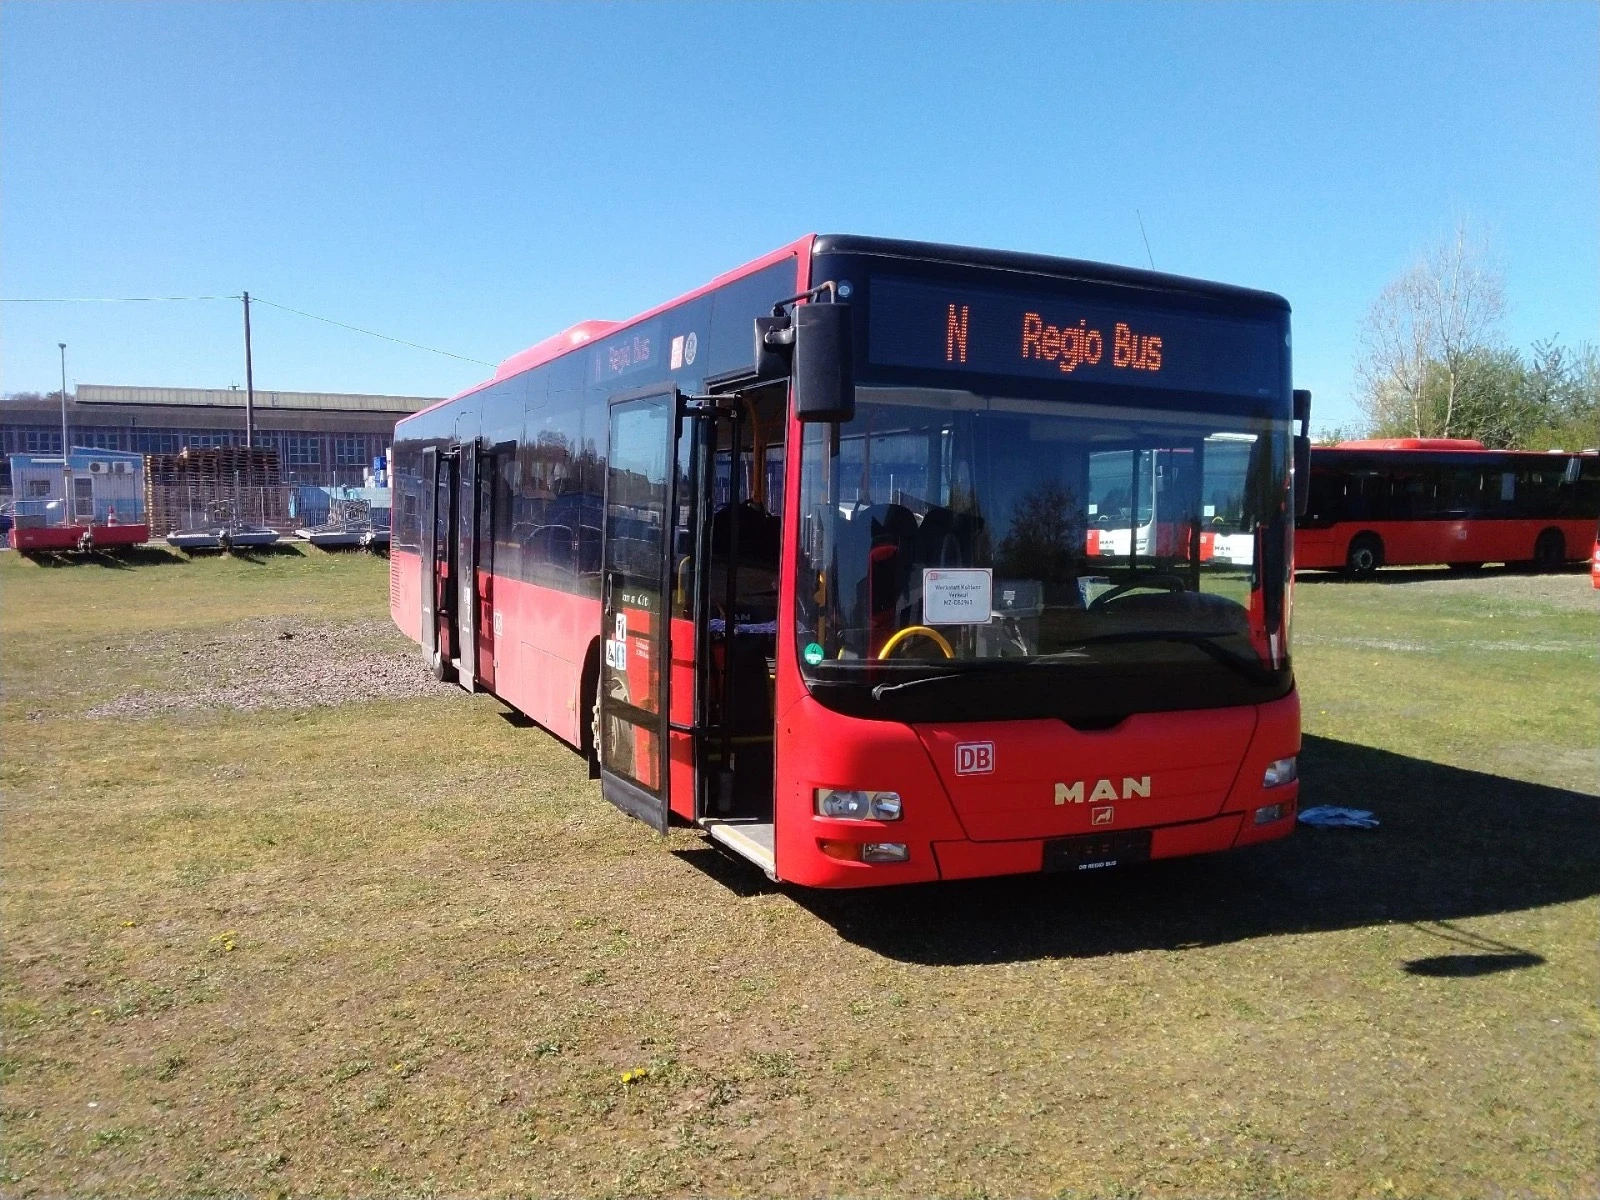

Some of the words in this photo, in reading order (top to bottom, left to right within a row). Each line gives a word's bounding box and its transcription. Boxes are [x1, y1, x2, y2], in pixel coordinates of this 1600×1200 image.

[946, 303, 969, 363] N
[1021, 312, 1102, 372] Regio
[1113, 322, 1162, 371] Bus
[811, 644, 817, 654] 4
[958, 746, 991, 771] DB
[1054, 776, 1151, 806] MAN
